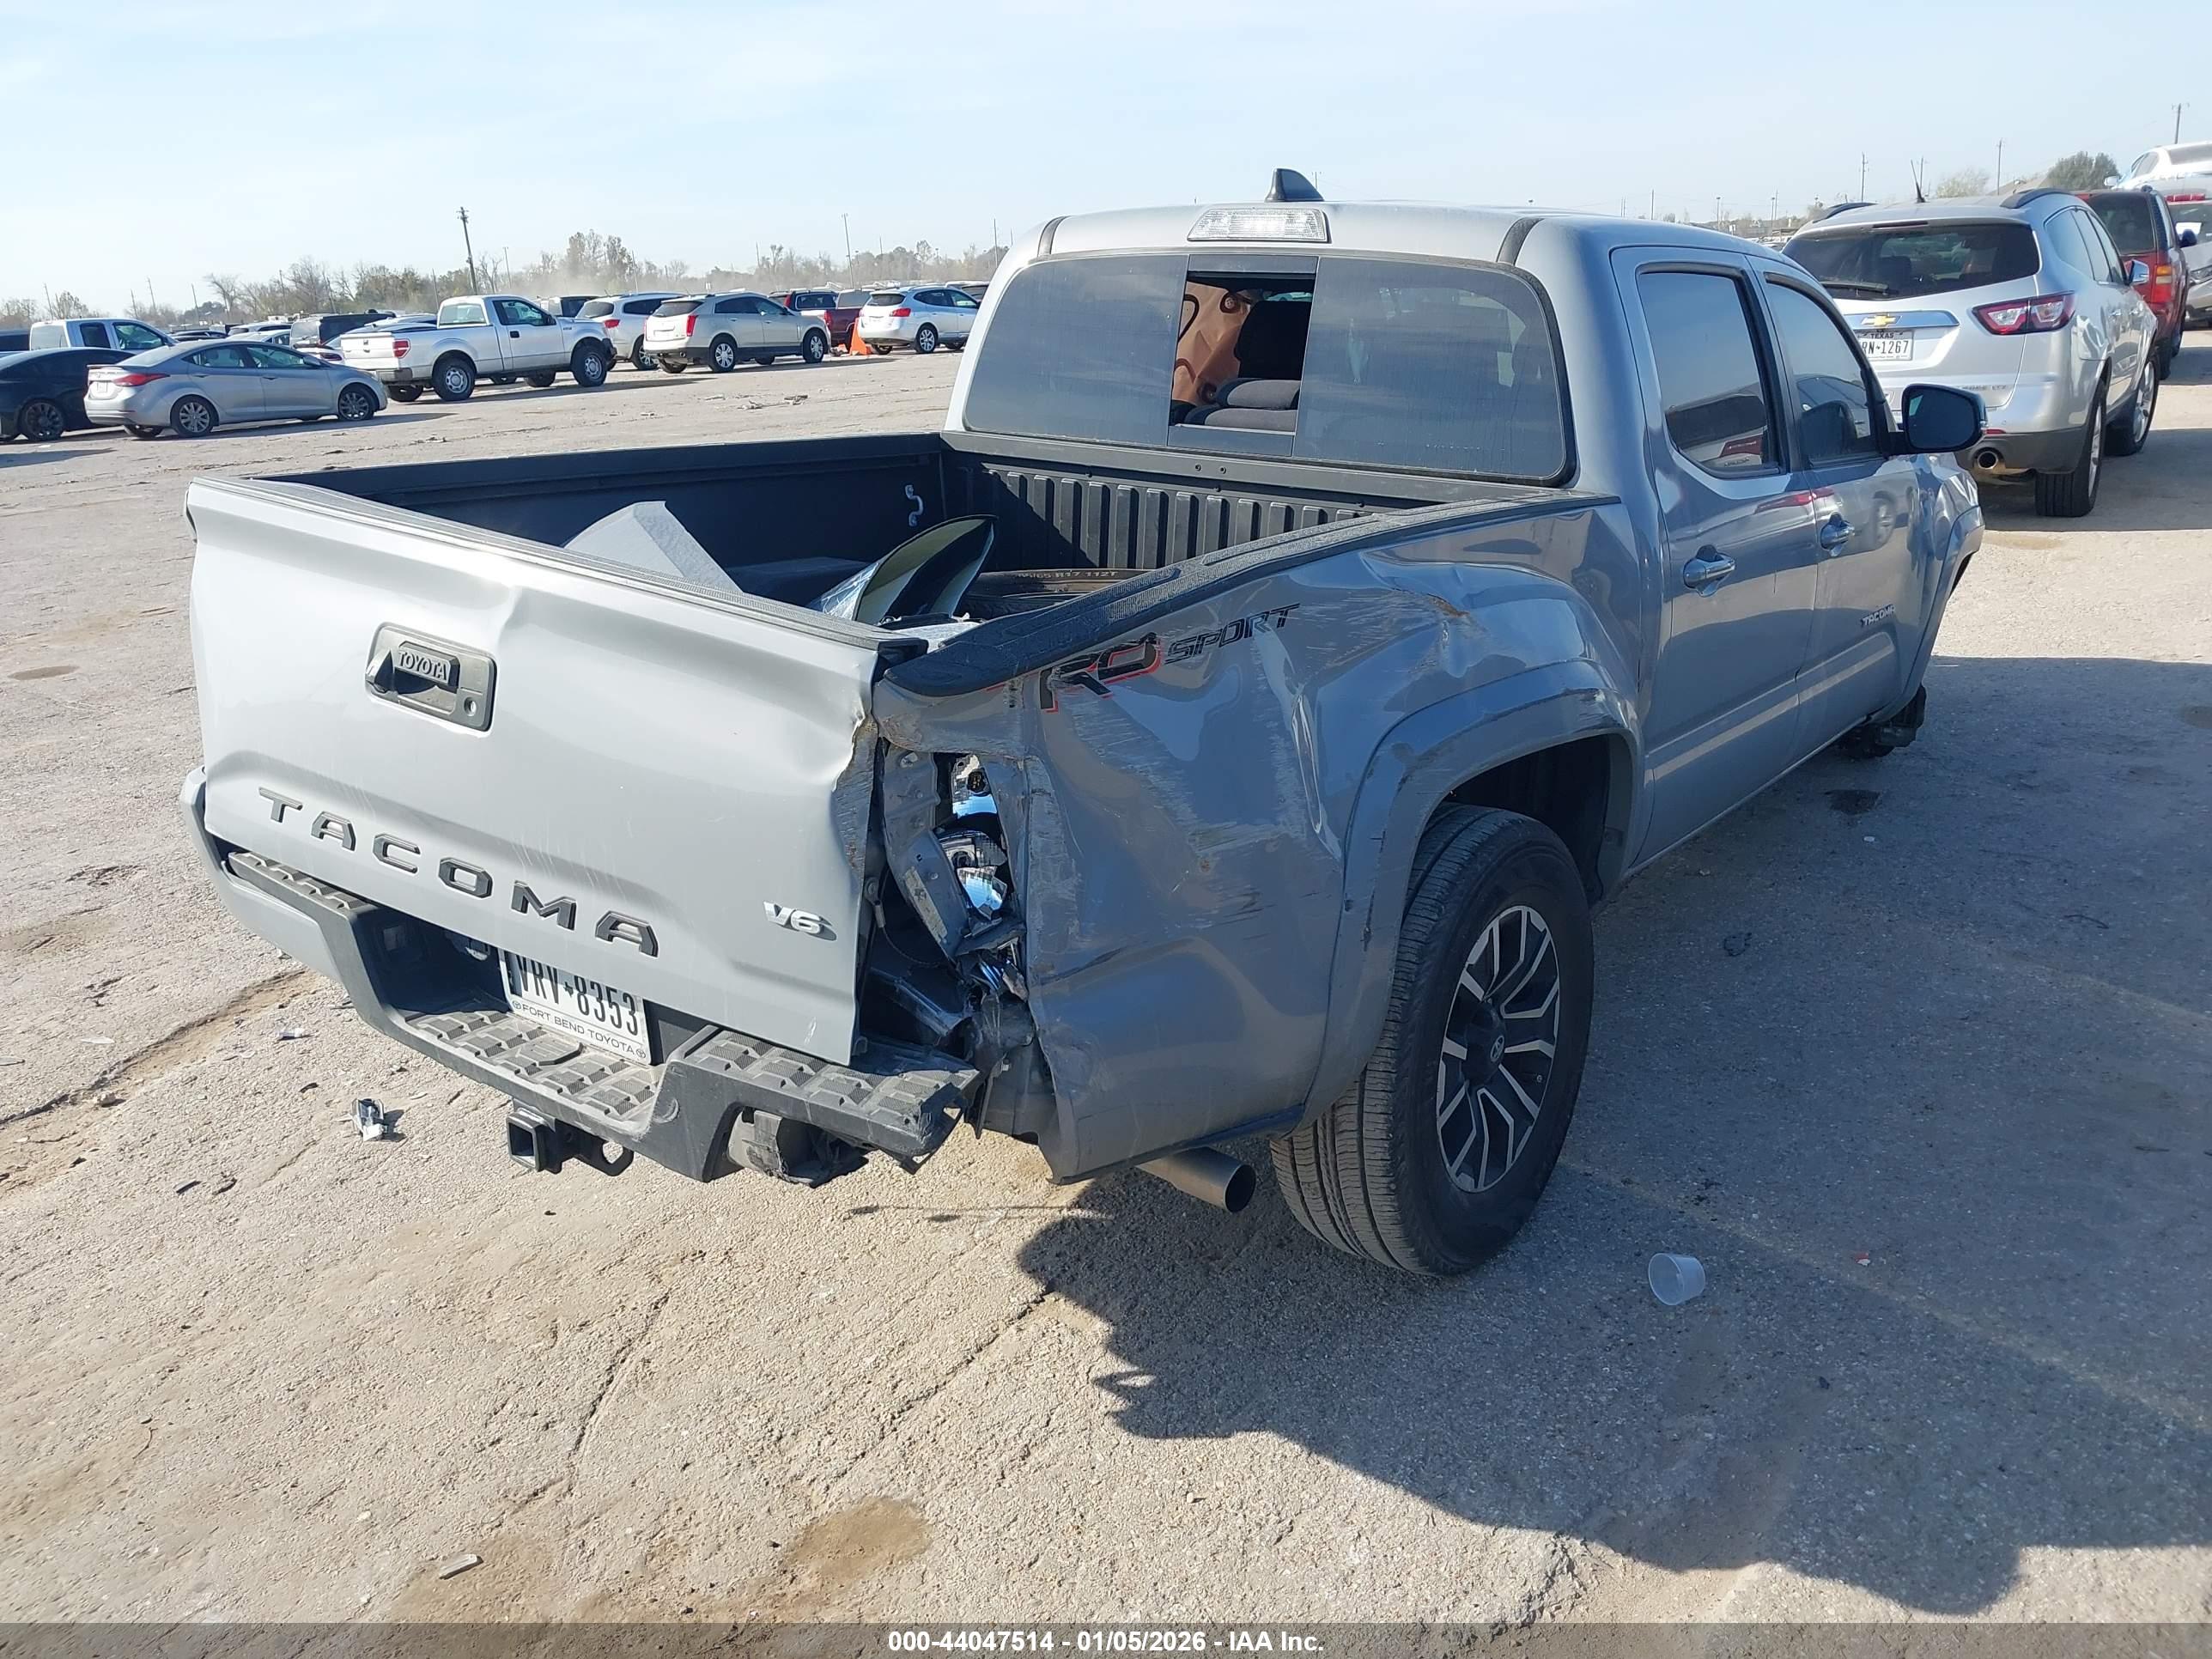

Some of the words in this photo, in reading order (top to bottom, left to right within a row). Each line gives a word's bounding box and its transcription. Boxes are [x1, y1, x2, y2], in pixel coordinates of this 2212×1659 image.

[1860, 341, 1875, 354] RN
[1881, 340, 1910, 354] 1267
[1164, 603, 1301, 665] SPORT
[398, 651, 447, 681] TOYOTA
[258, 787, 659, 958] TACOMA
[763, 901, 822, 935] V6
[521, 1003, 551, 1022] FORT
[554, 1015, 585, 1035] BEND
[587, 1029, 635, 1055] TOYOTA
[574, 975, 639, 1036] 8353
